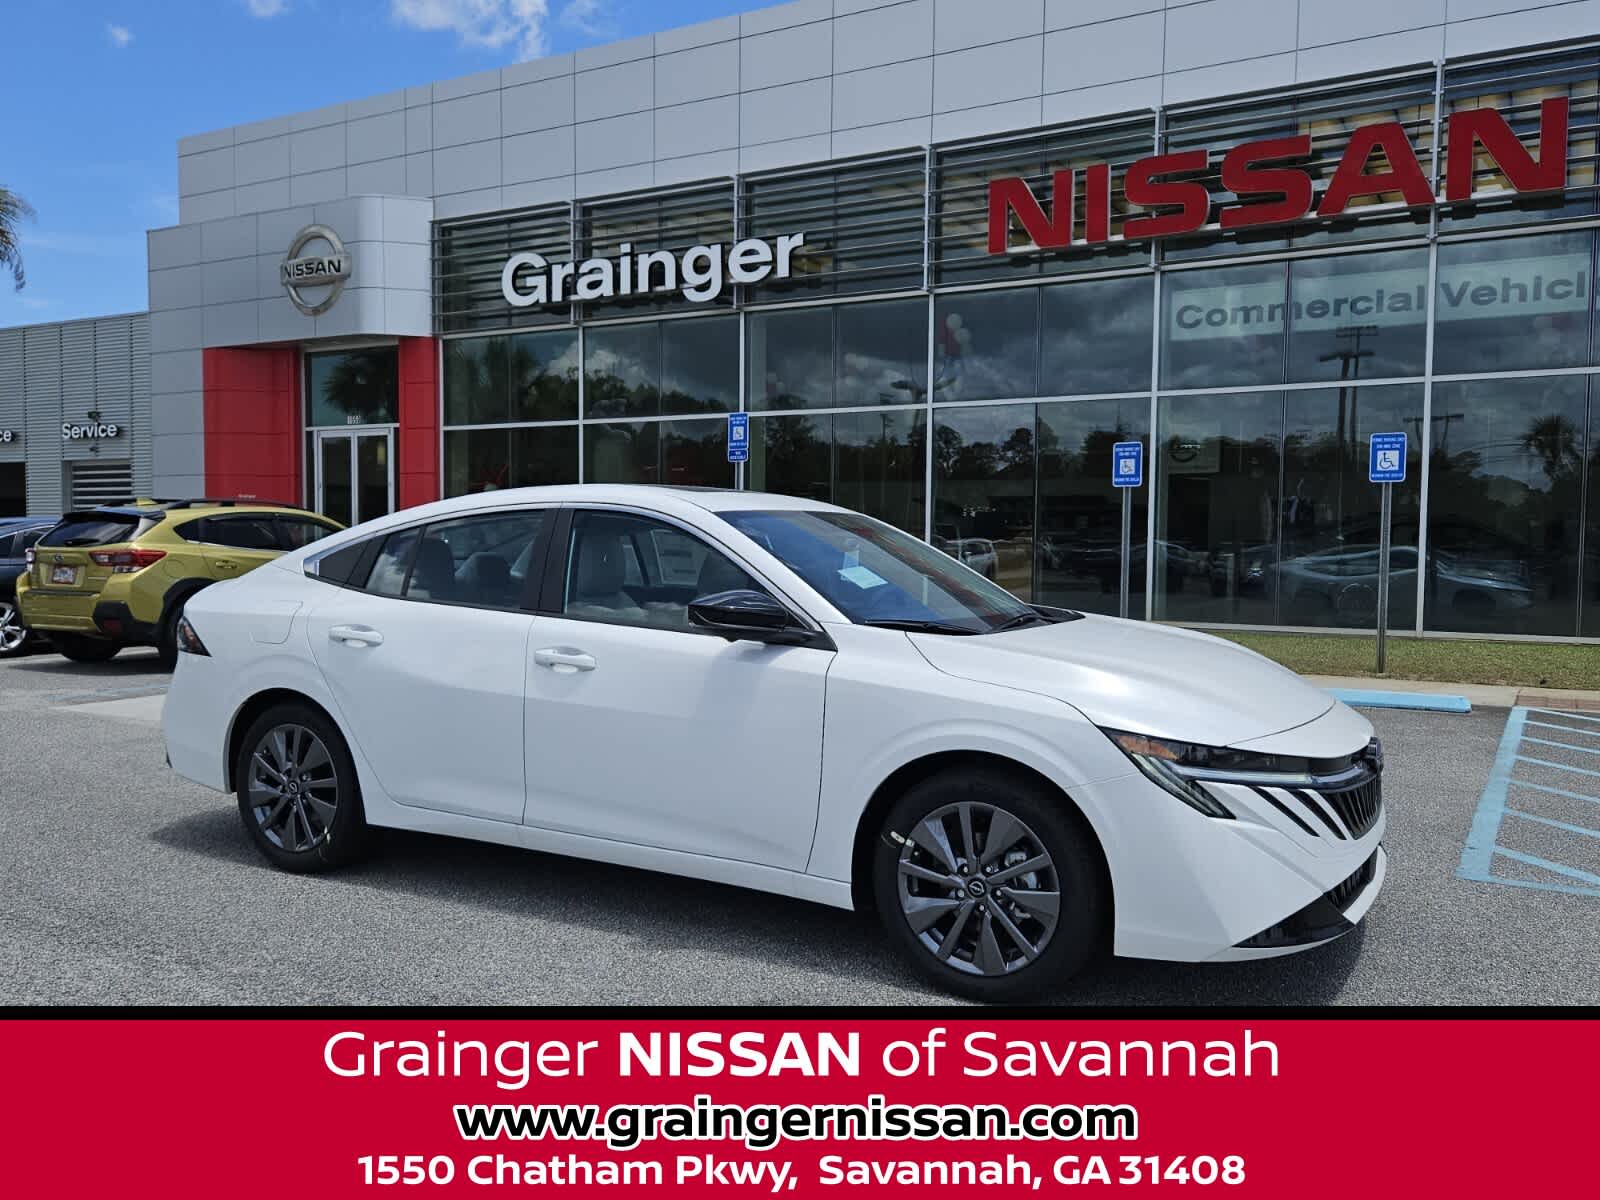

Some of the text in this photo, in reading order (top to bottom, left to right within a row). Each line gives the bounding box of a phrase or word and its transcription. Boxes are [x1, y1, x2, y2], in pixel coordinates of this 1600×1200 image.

[988, 97, 1569, 253] NISSAN
[283, 259, 341, 278] NISSAN
[501, 232, 804, 307] Grainger
[1176, 271, 1600, 329] Commercial Vehicl
[62, 423, 117, 438] Service
